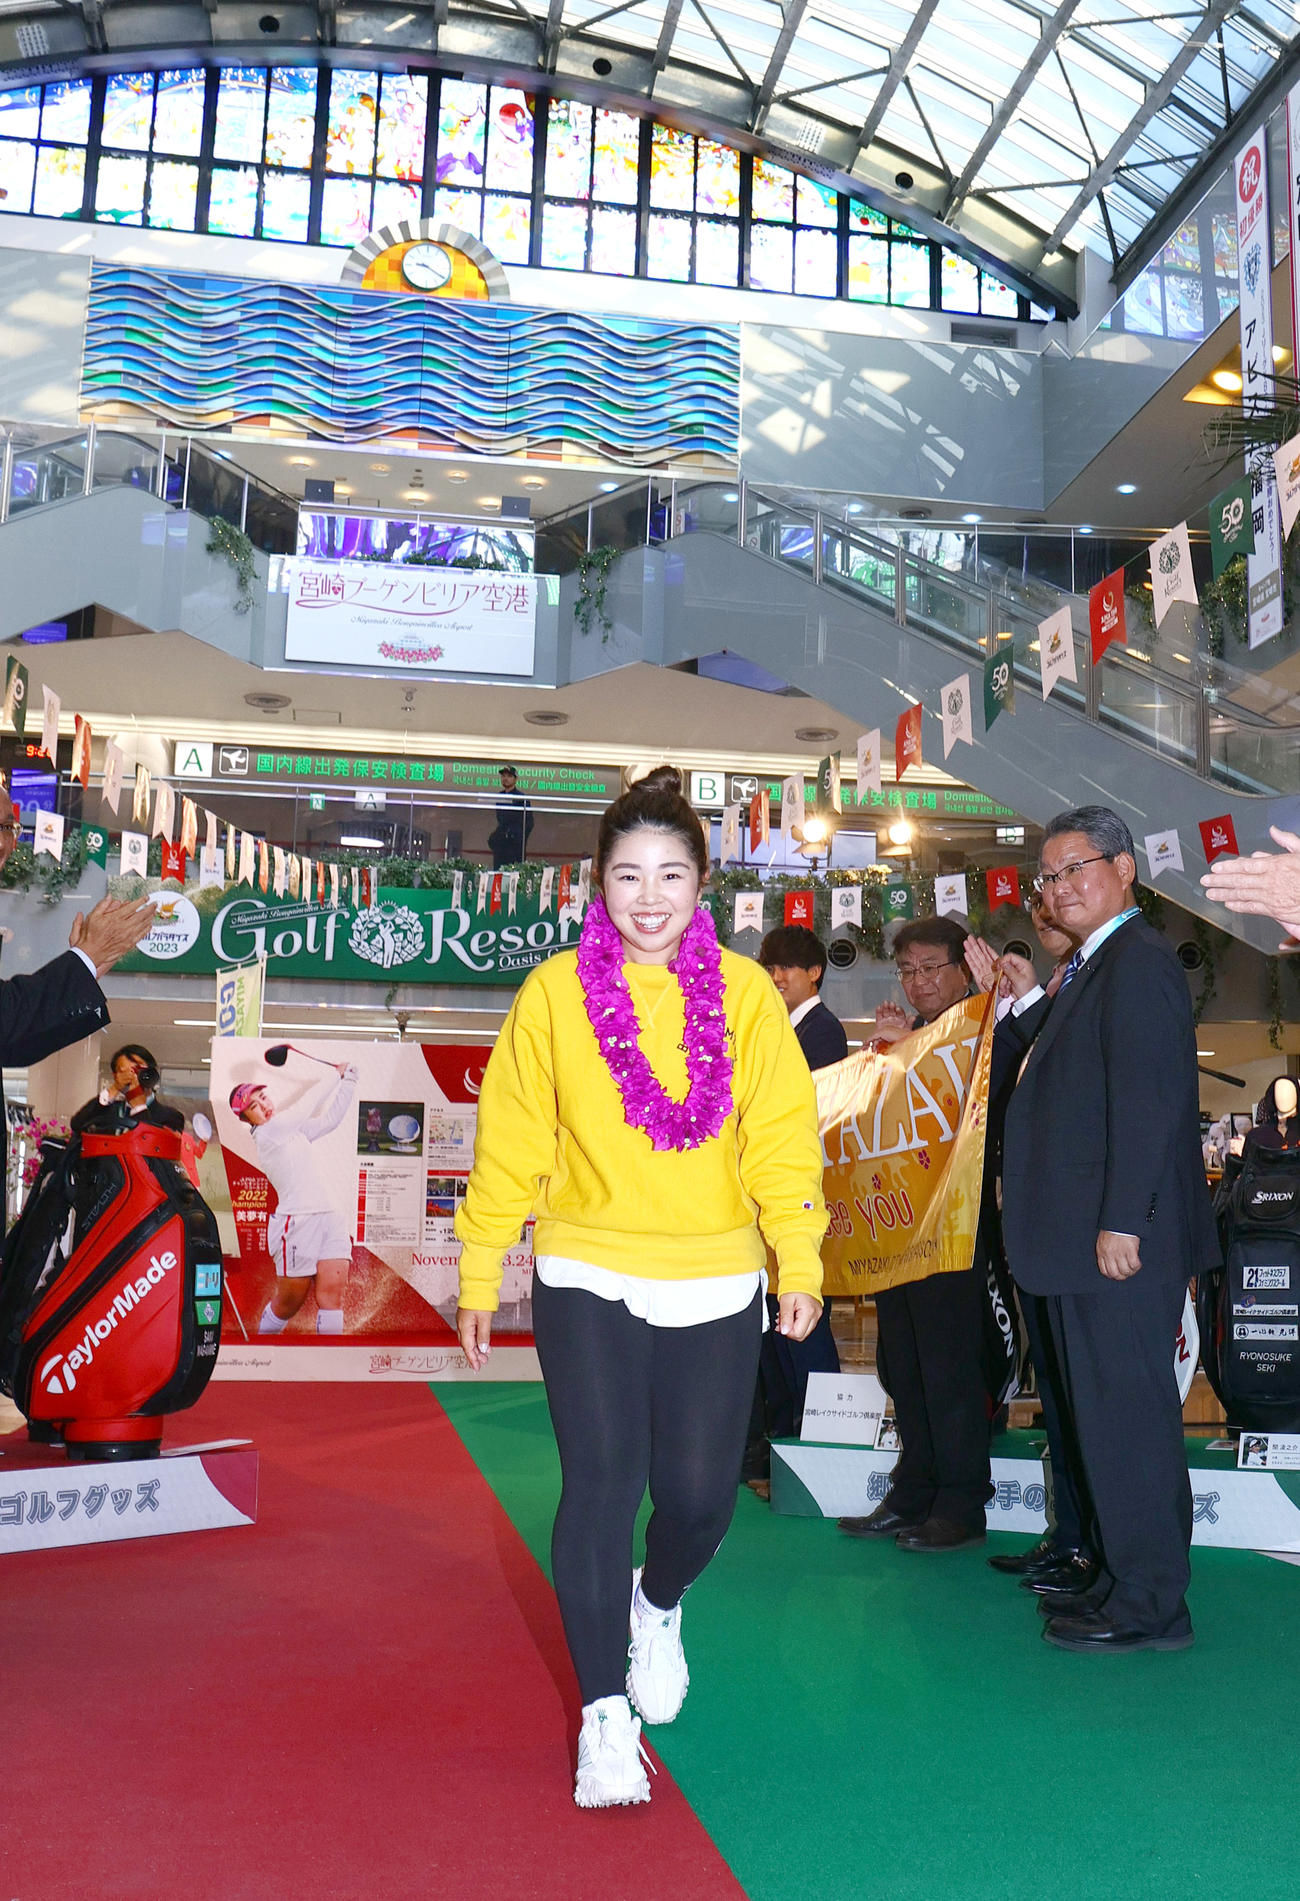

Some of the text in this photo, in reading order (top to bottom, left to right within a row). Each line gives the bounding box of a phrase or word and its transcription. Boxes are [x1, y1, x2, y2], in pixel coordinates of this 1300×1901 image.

[1242, 155, 1258, 196] 祝
[1221, 498, 1244, 534] 50
[296, 571, 530, 615] 宮崎ブーゲンビリア空港
[992, 662, 1009, 691] 50
[183, 748, 203, 772] A
[256, 753, 446, 784] 国内線出発保安検査場
[452, 761, 596, 780] Domesti ecurity Check
[699, 778, 717, 801] B
[366, 793, 378, 809] A
[86, 831, 104, 848] 50
[889, 889, 908, 905] 50
[211, 898, 574, 972] Golf Resor
[149, 942, 179, 953] 2023
[499, 953, 542, 970] Oasis
[232, 1200, 267, 1209] hampion
[238, 1190, 268, 1201] 2022
[1251, 1190, 1295, 1204] SRIXON
[1247, 1267, 1259, 1288] 21
[40, 1250, 178, 1395] TaylorMade
[1239, 1351, 1293, 1362] RYONOSUKE
[1256, 1363, 1276, 1374] SEKI
[0, 1478, 161, 1526] ゴルフグッズ
